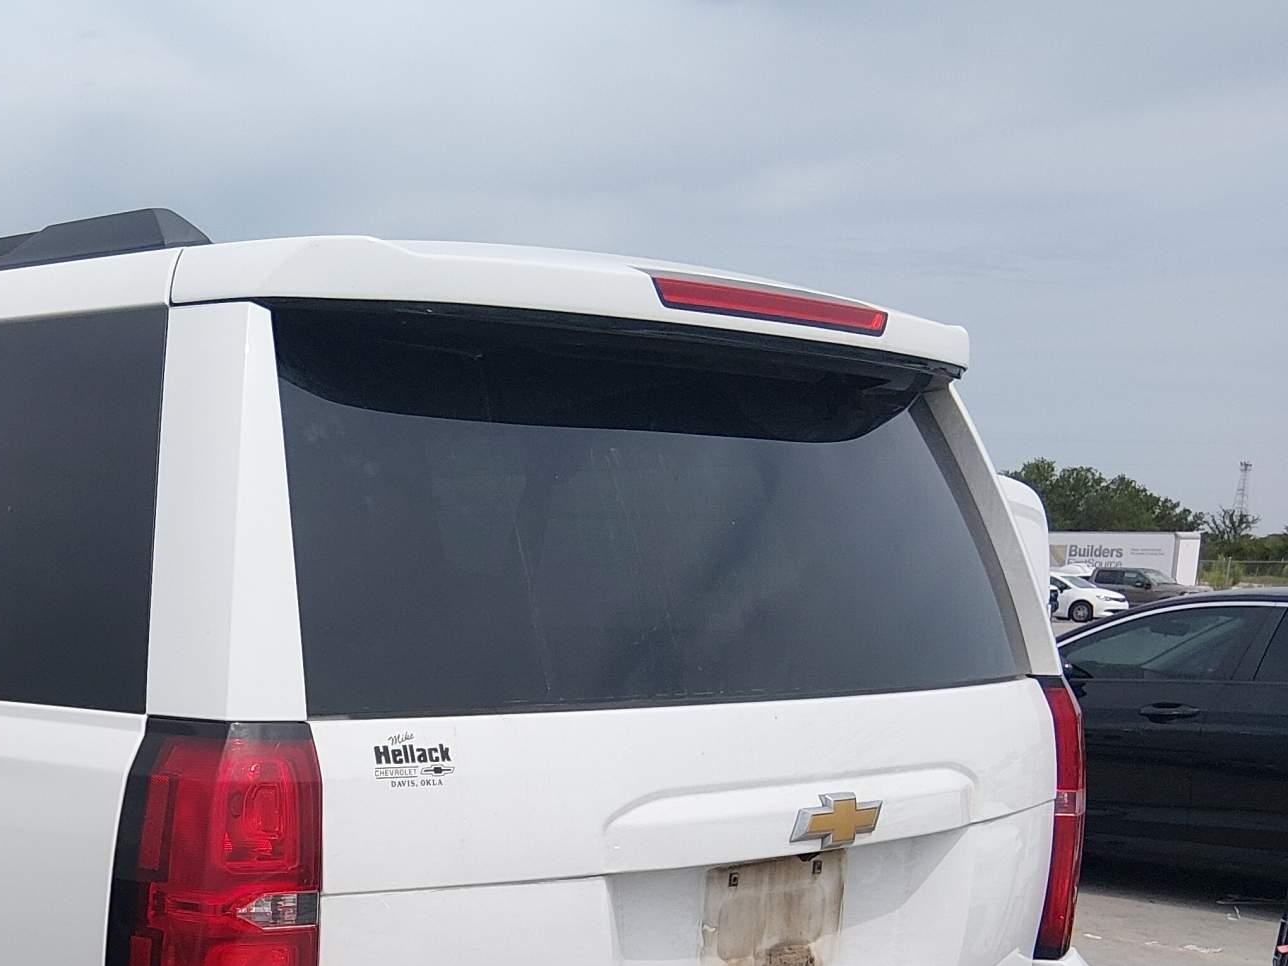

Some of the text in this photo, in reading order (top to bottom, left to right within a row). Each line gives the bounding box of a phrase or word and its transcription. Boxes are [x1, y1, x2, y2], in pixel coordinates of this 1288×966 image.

[1068, 544, 1123, 558] Builders
[1067, 558, 1122, 568] FSource
[388, 731, 414, 746] Mike
[374, 743, 452, 765] Hellack
[374, 768, 418, 777] CHEVROLET
[391, 778, 443, 788] DAVIS, OKLA
